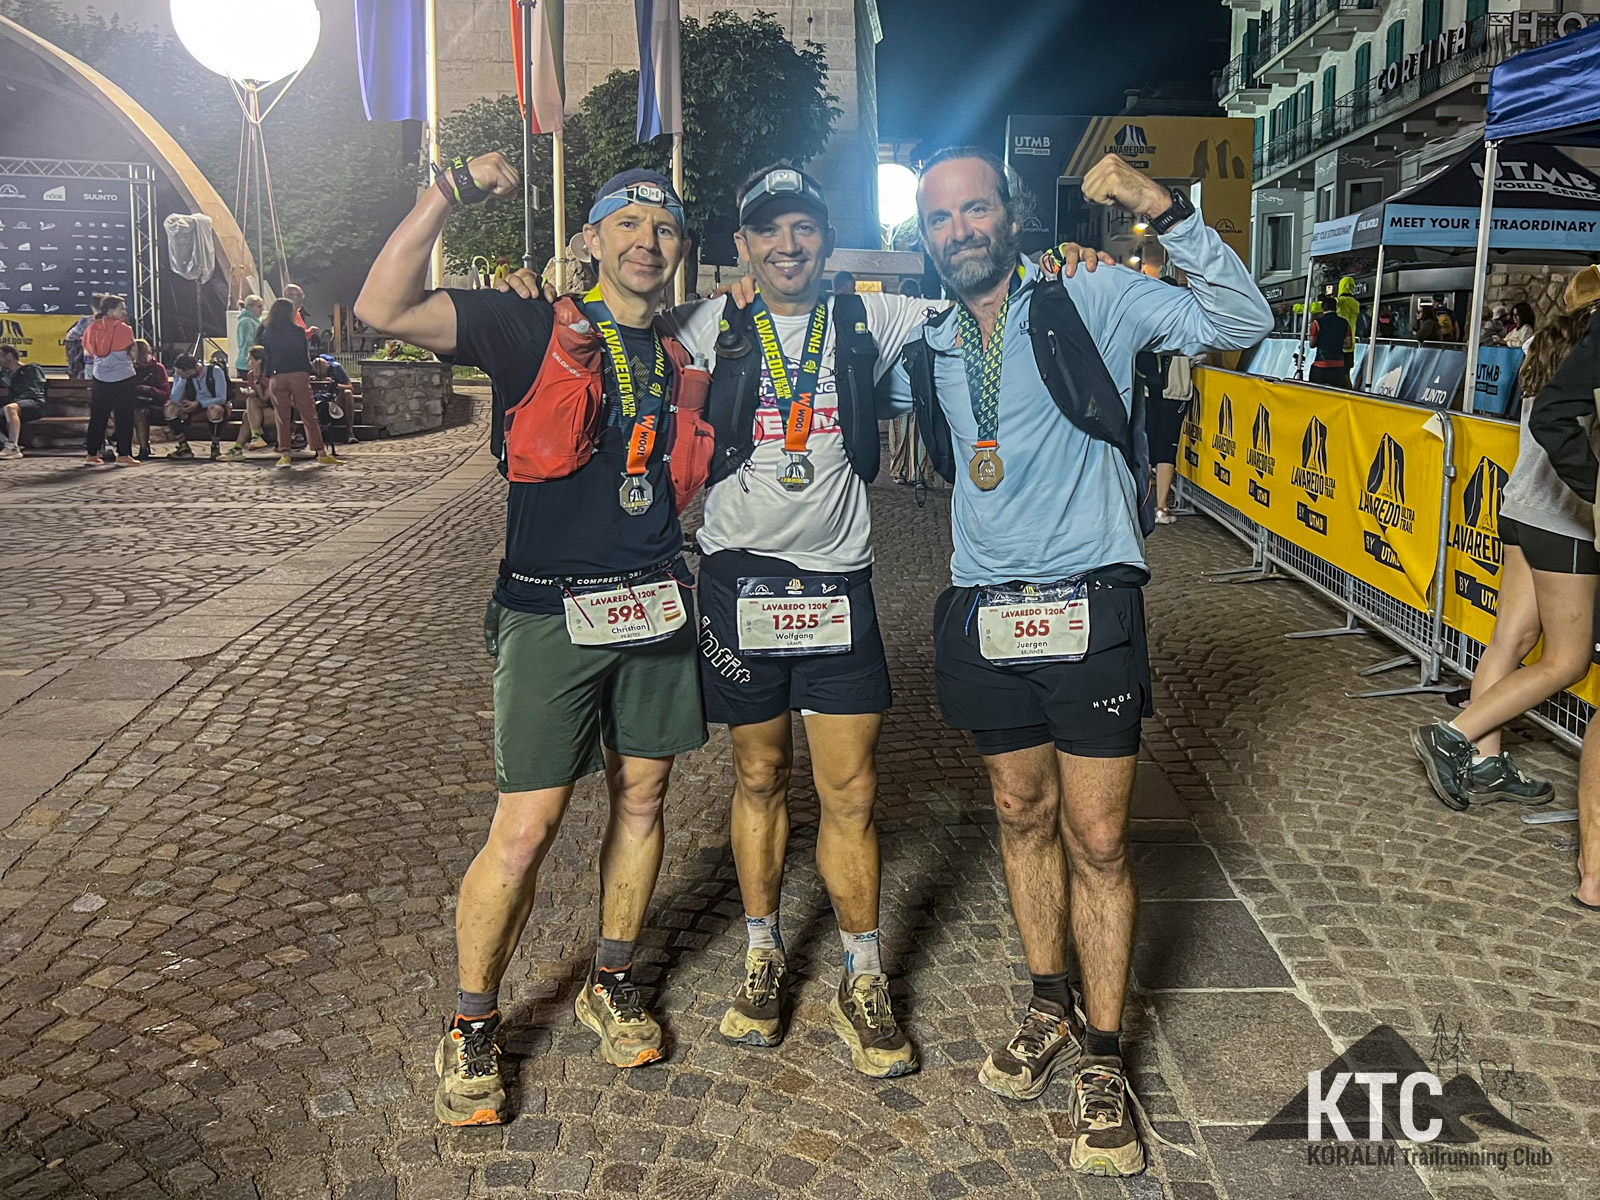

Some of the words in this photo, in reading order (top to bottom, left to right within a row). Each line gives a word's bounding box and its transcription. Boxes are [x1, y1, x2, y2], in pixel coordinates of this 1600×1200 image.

[1376, 21, 1467, 95] CORTINA
[1015, 136, 1050, 147] UTMB
[1104, 146, 1144, 154] LAVAREDO
[1494, 182, 1546, 190] ORLD
[1390, 217, 1425, 228] MEET
[1430, 217, 1470, 229] YOUR
[1475, 218, 1597, 232] ETRAORDINARY
[753, 310, 786, 378] LAVAREDO
[552, 352, 581, 377] SALOMON
[597, 320, 634, 394] LAVAREDO
[1475, 363, 1500, 382] UTMB
[1291, 466, 1325, 496] LAVAREDO
[1325, 477, 1336, 489] ULTRA
[1358, 489, 1401, 528] LAVREDO
[1401, 506, 1415, 522] ULTRA
[1308, 514, 1324, 530] UTMB
[1400, 519, 1413, 534] TRAIL
[1365, 535, 1376, 550] BY
[590, 594, 635, 607] LAVAREDO
[637, 589, 657, 599] 120K
[1459, 576, 1469, 593] BY
[1481, 589, 1498, 611] UTM
[607, 602, 646, 625] 598
[762, 603, 806, 611] LAVAREDO
[1001, 608, 1042, 619] LAVAREDO
[1044, 607, 1065, 616] 120K
[611, 624, 647, 634] Christian
[772, 613, 819, 631] 1255
[1014, 619, 1050, 638] 565
[775, 633, 814, 641] Wolfgang
[1016, 641, 1048, 649] Juergen
[1092, 692, 1132, 709] HYROX
